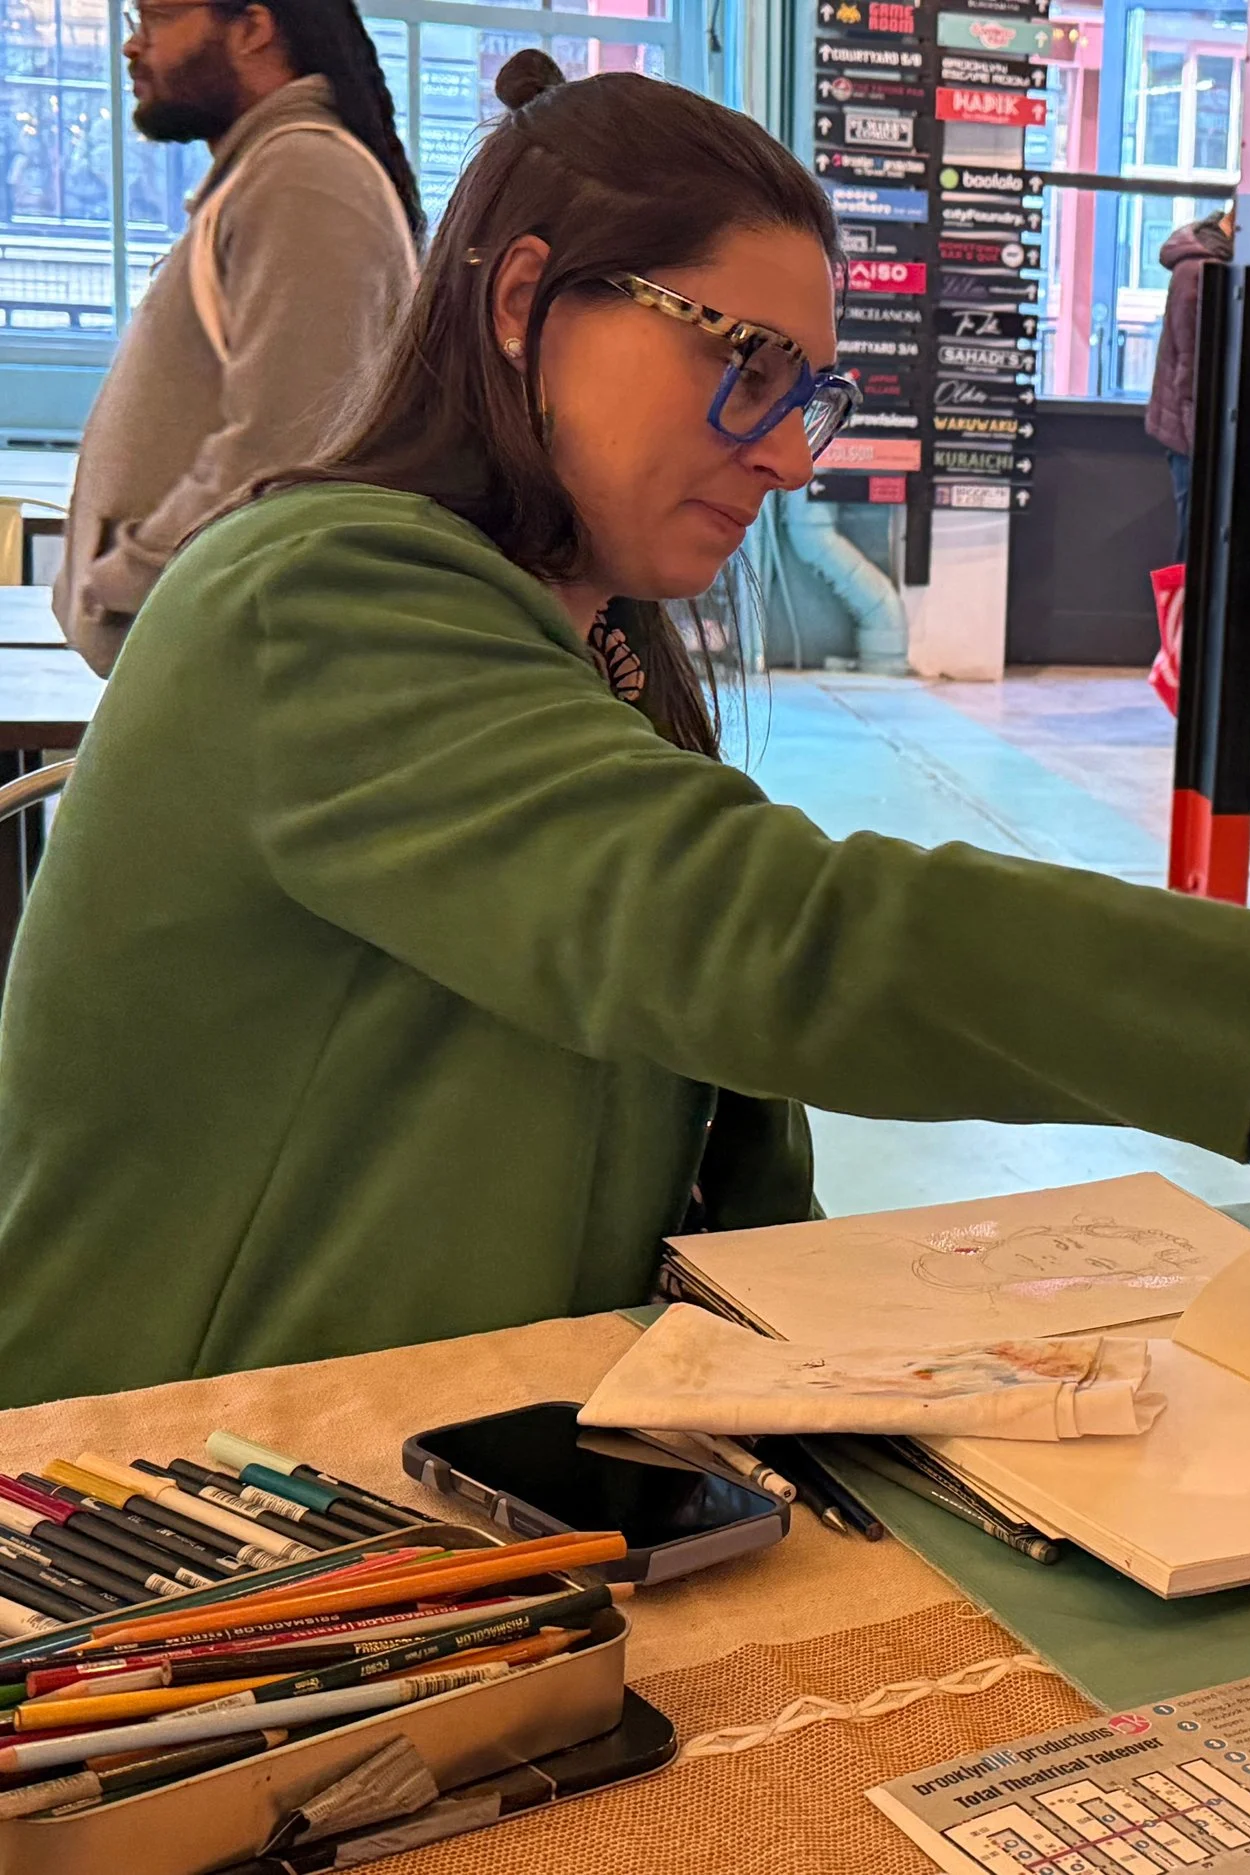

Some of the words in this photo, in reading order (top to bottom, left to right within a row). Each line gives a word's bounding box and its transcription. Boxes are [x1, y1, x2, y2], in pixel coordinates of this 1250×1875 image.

[868, 2, 914, 17] GAME
[869, 17, 914, 33] ROOM
[952, 90, 1020, 116] HAPIK
[933, 416, 1018, 433] WAKUWAKU
[933, 451, 1014, 471] KURAICHI
[233, 1613, 341, 1636] PRISMACOLOR
[455, 1614, 531, 1648] PRISMACOLOR
[1017, 1725, 1115, 1766] productions
[953, 1784, 1003, 1810] Total
[999, 1757, 1089, 1795] Theatrical
[1083, 1735, 1166, 1770] Takeover
